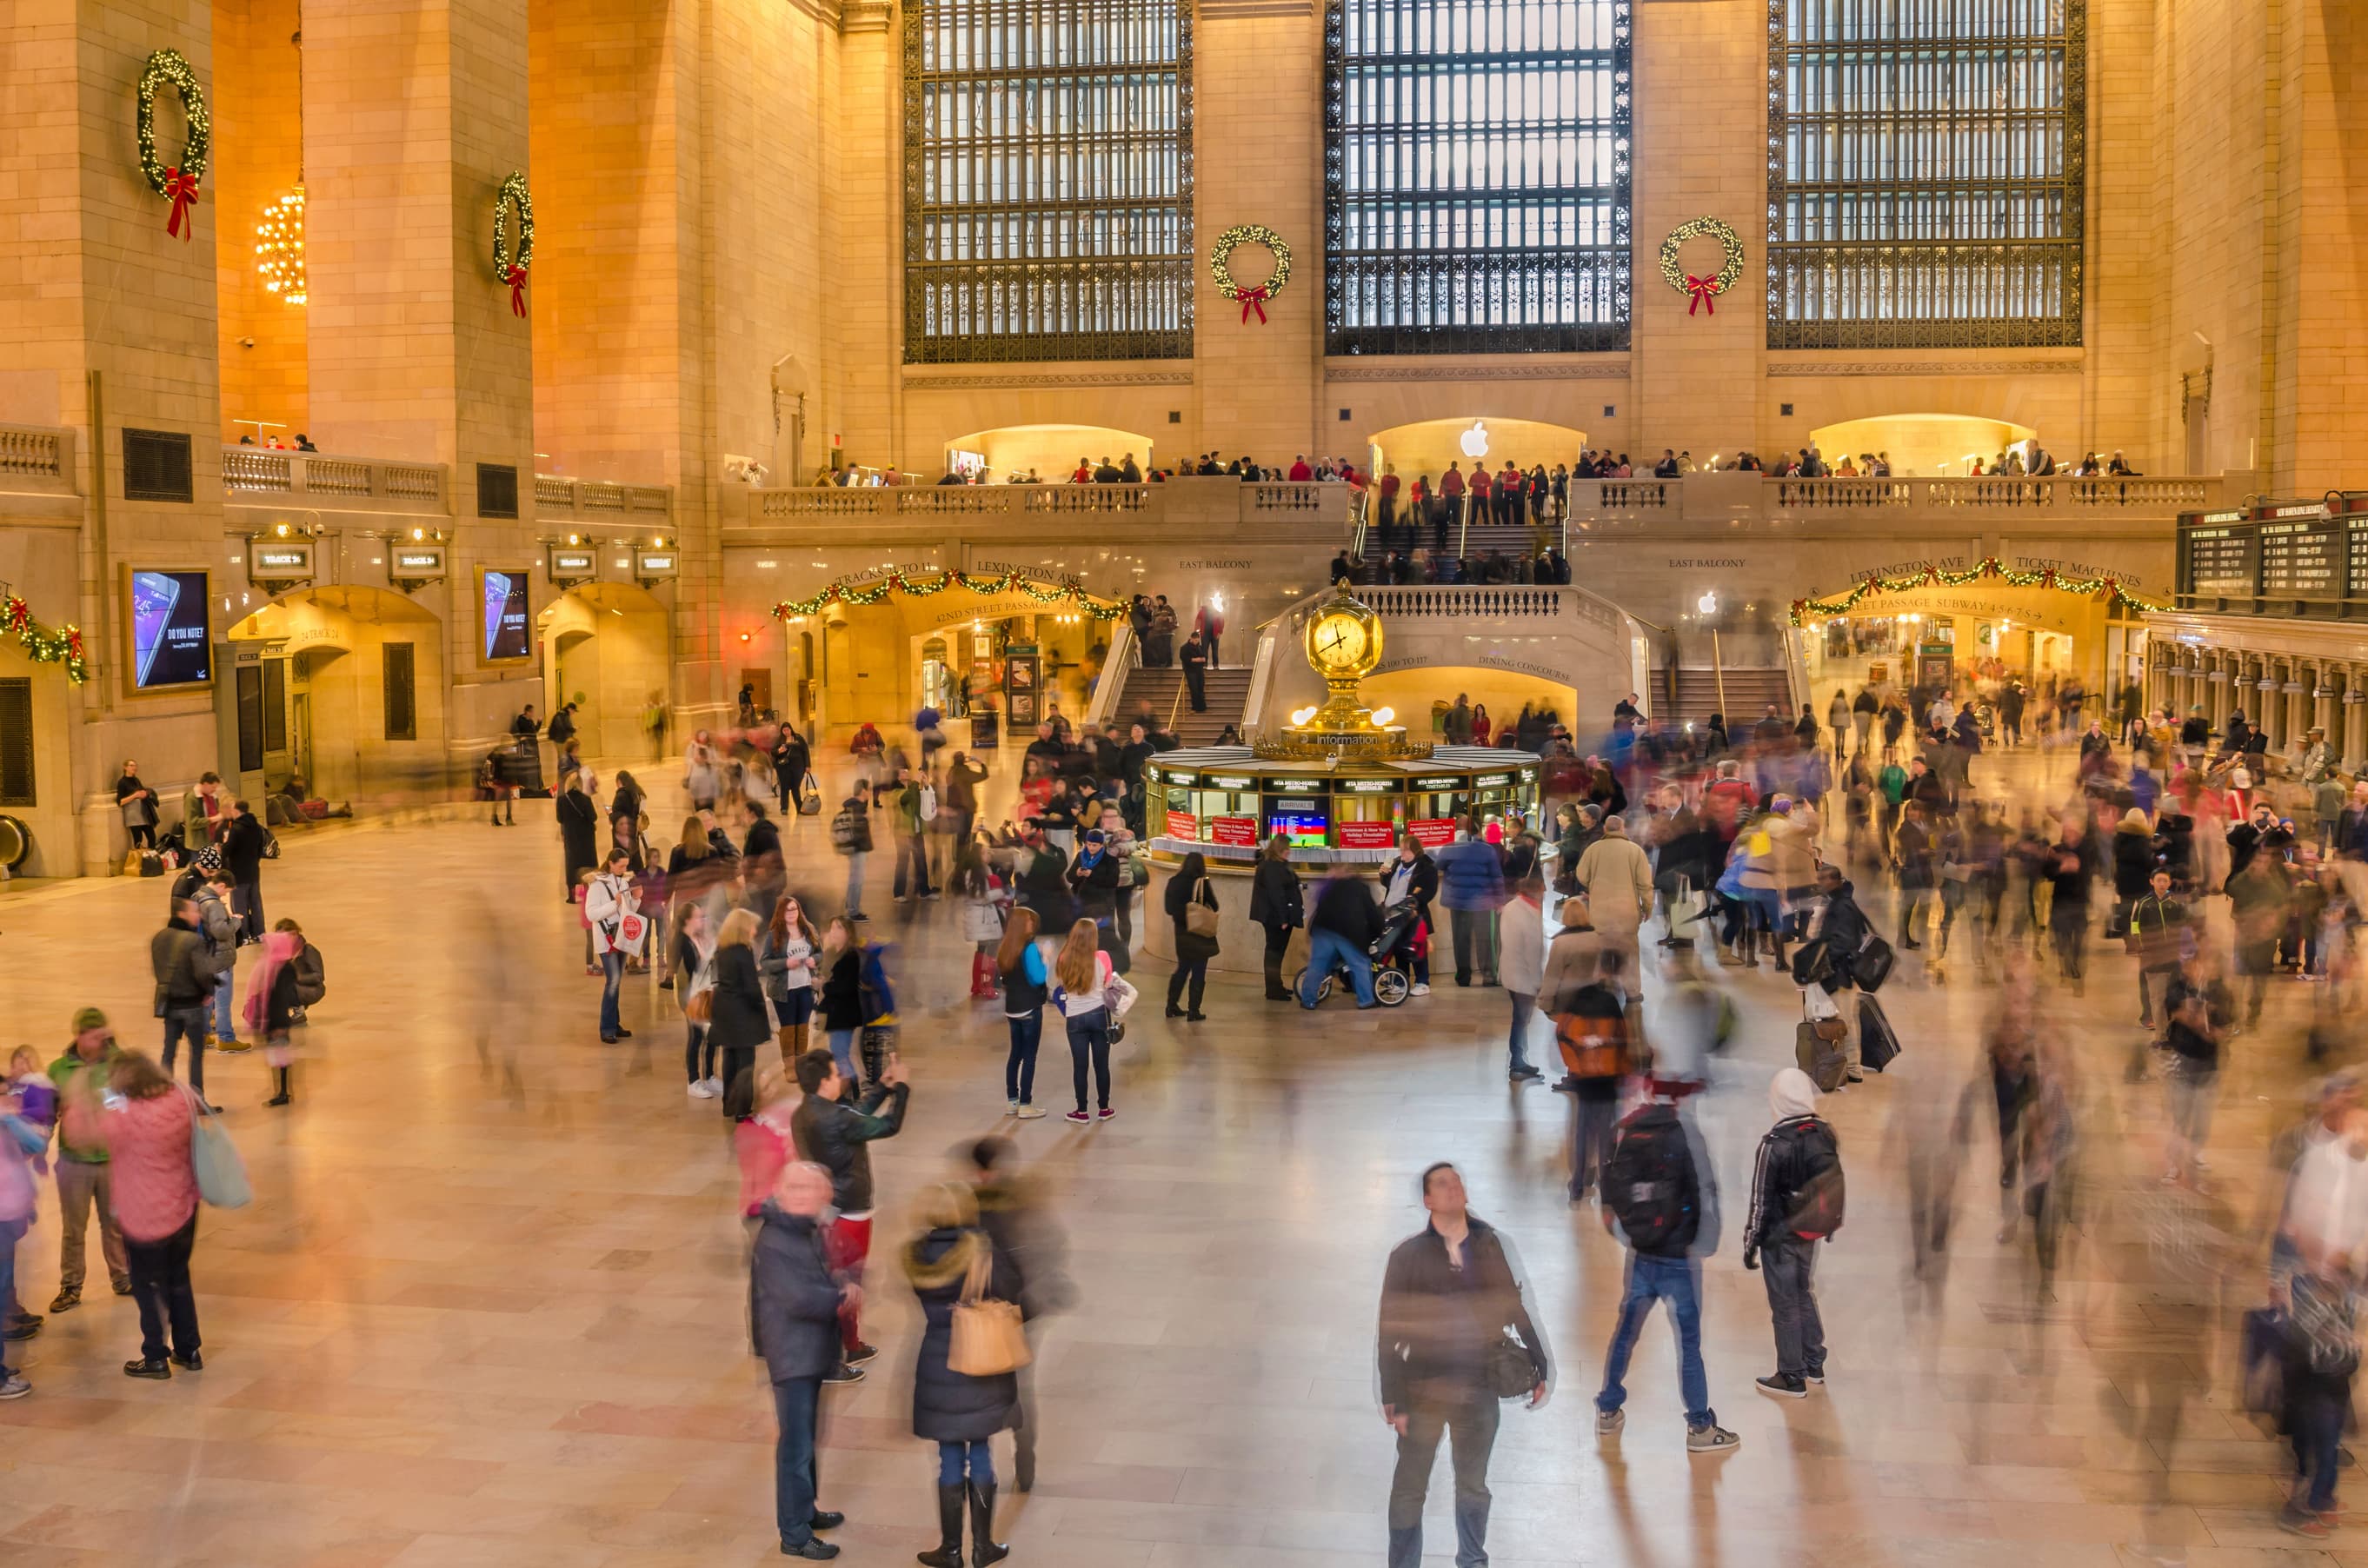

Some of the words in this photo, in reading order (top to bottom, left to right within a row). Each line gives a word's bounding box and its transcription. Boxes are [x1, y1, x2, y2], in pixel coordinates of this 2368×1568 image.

[978, 561, 1054, 580] LEXINGTON
[1058, 572, 1081, 584] AVE
[1206, 560, 1252, 568] BALCONY
[1669, 559, 1694, 568] EAST
[1697, 559, 1746, 568] BALCONY
[1850, 559, 1933, 583] LEXINGTON
[1939, 556, 1965, 568] AVE
[2016, 557, 2065, 570] TICKET
[2070, 562, 2142, 588] MACHINES
[837, 569, 884, 586] TRACKS
[901, 562, 919, 574] TO
[935, 611, 962, 622] 42ND
[965, 604, 1002, 615] STREET
[1006, 601, 1050, 611] PASSAGE
[1849, 601, 1877, 612] REET
[1880, 598, 1930, 608] PASSAGE
[1936, 598, 1986, 610] SUBWAY
[2015, 607, 2022, 616] 7
[168, 628, 176, 640] DO
[176, 628, 188, 640] YOU
[309, 628, 330, 640] TRACK
[1387, 660, 1400, 668] 100
[1401, 657, 1414, 666] TO
[1416, 655, 1427, 664] 117
[1479, 656, 1515, 668] DINING
[1516, 661, 1571, 682] CONCOURSE
[1317, 734, 1378, 745] Information
